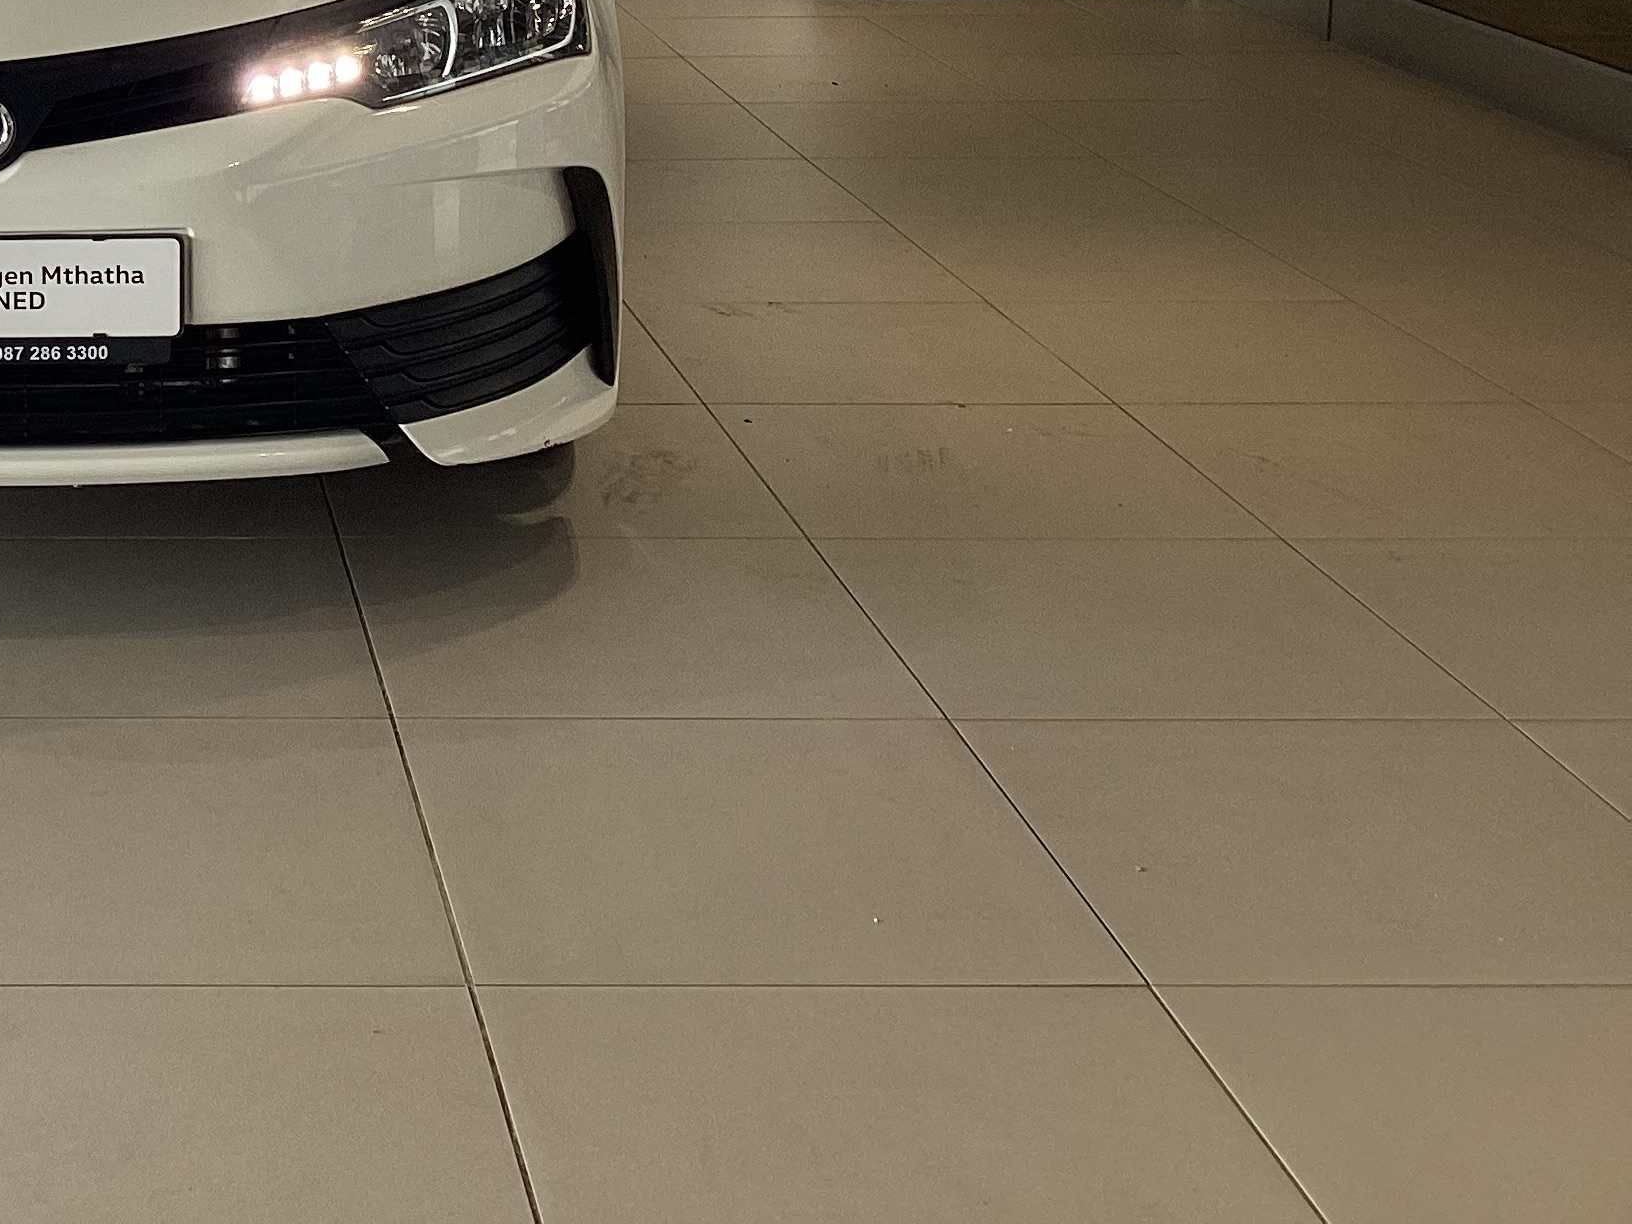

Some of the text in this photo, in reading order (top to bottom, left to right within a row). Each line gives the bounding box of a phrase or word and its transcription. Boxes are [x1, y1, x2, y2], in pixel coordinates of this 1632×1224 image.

[41, 264, 145, 285] Mthatha
[29, 346, 62, 361] 286
[66, 345, 109, 361] 3300
